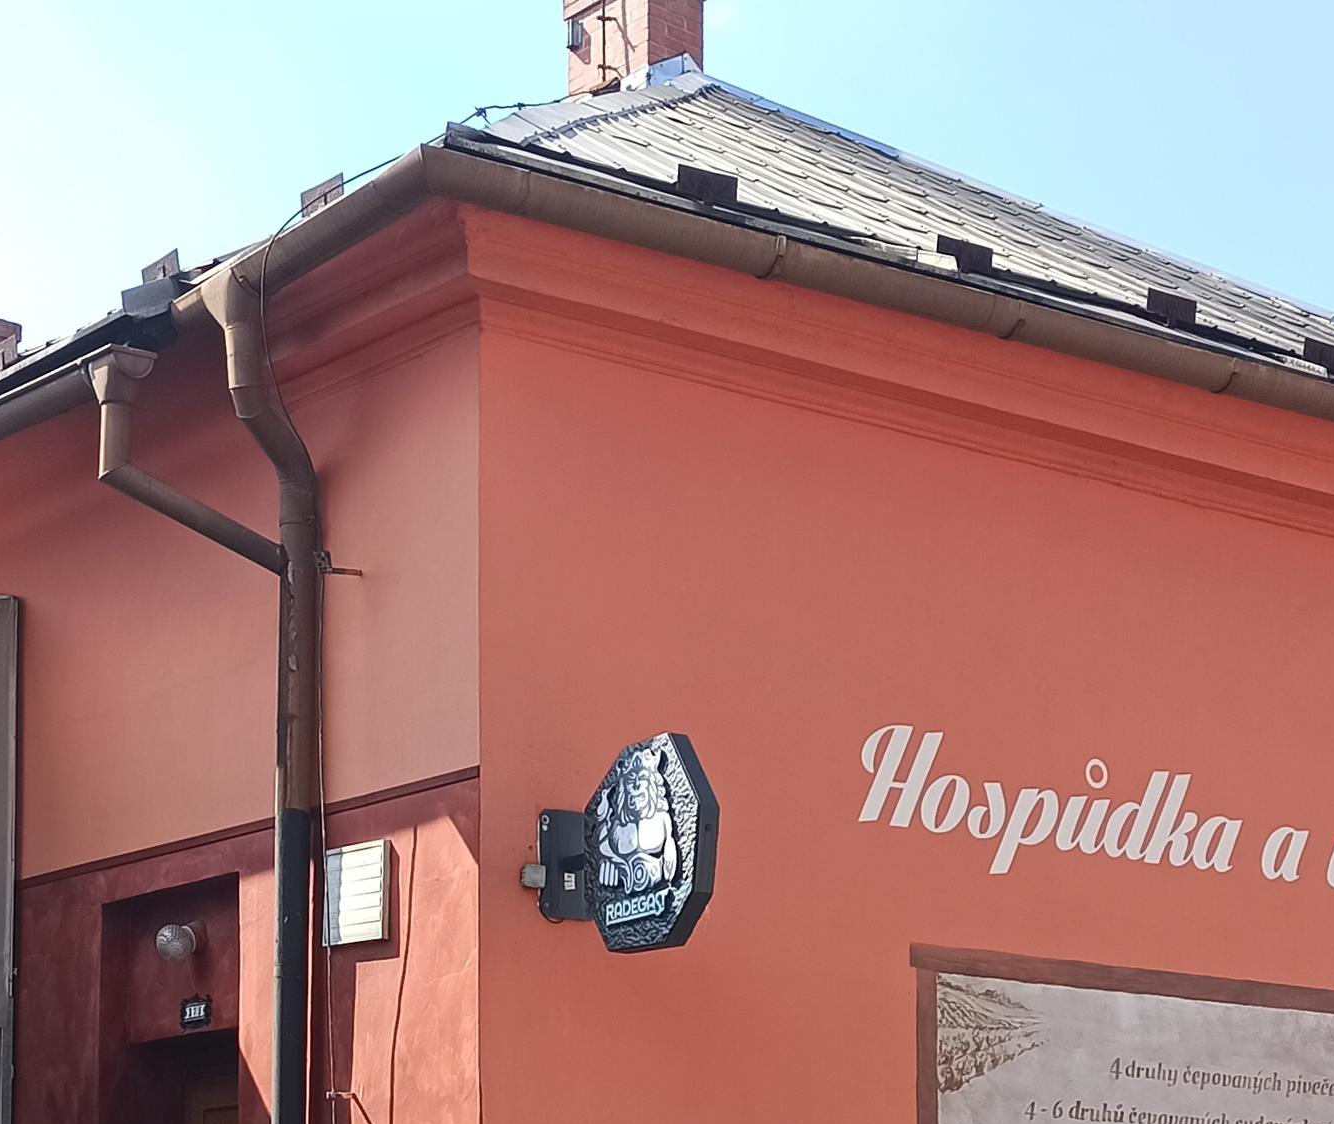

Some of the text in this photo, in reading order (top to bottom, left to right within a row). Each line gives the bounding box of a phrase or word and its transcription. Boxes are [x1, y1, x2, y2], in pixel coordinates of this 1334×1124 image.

[858, 725, 1243, 875] Hospůdka
[1261, 826, 1309, 882] a
[606, 887, 670, 926] RADEGAST
[1110, 1057, 1123, 1080] 4
[1125, 1060, 1178, 1087] druhy
[1182, 1065, 1282, 1096] čepovaných
[1024, 1101, 1036, 1121] 4
[1052, 1099, 1064, 1119] 6
[1068, 1100, 1125, 1123] druhů
